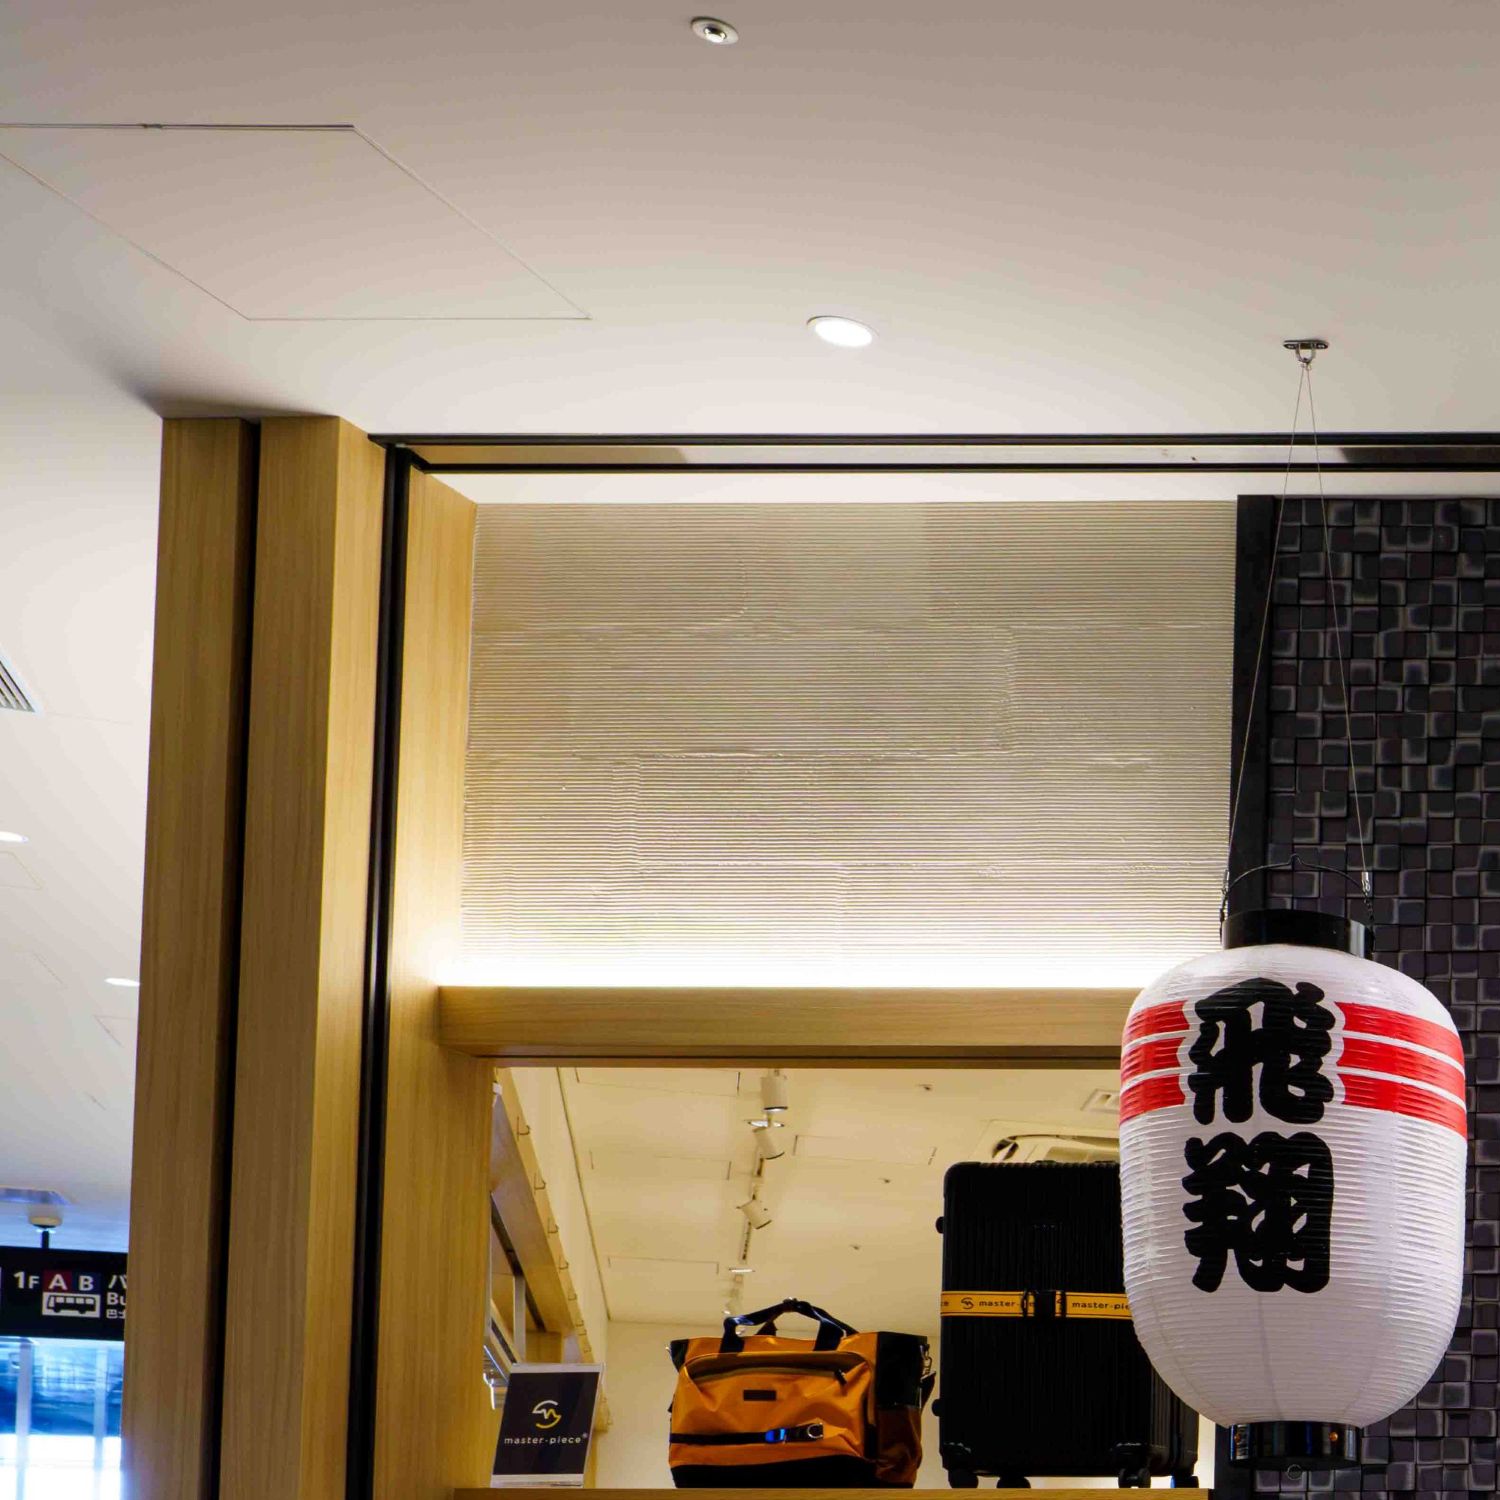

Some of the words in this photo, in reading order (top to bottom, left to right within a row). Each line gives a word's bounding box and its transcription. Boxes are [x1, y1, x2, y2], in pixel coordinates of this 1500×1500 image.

[1182, 977, 1336, 1293] 飛翔
[13, 1271, 39, 1289] 1F
[48, 1273, 68, 1290] A
[79, 1275, 94, 1291] B
[979, 1300, 1033, 1309] master-
[1072, 1300, 1130, 1311] master-pie
[504, 1435, 583, 1445] master-piece
